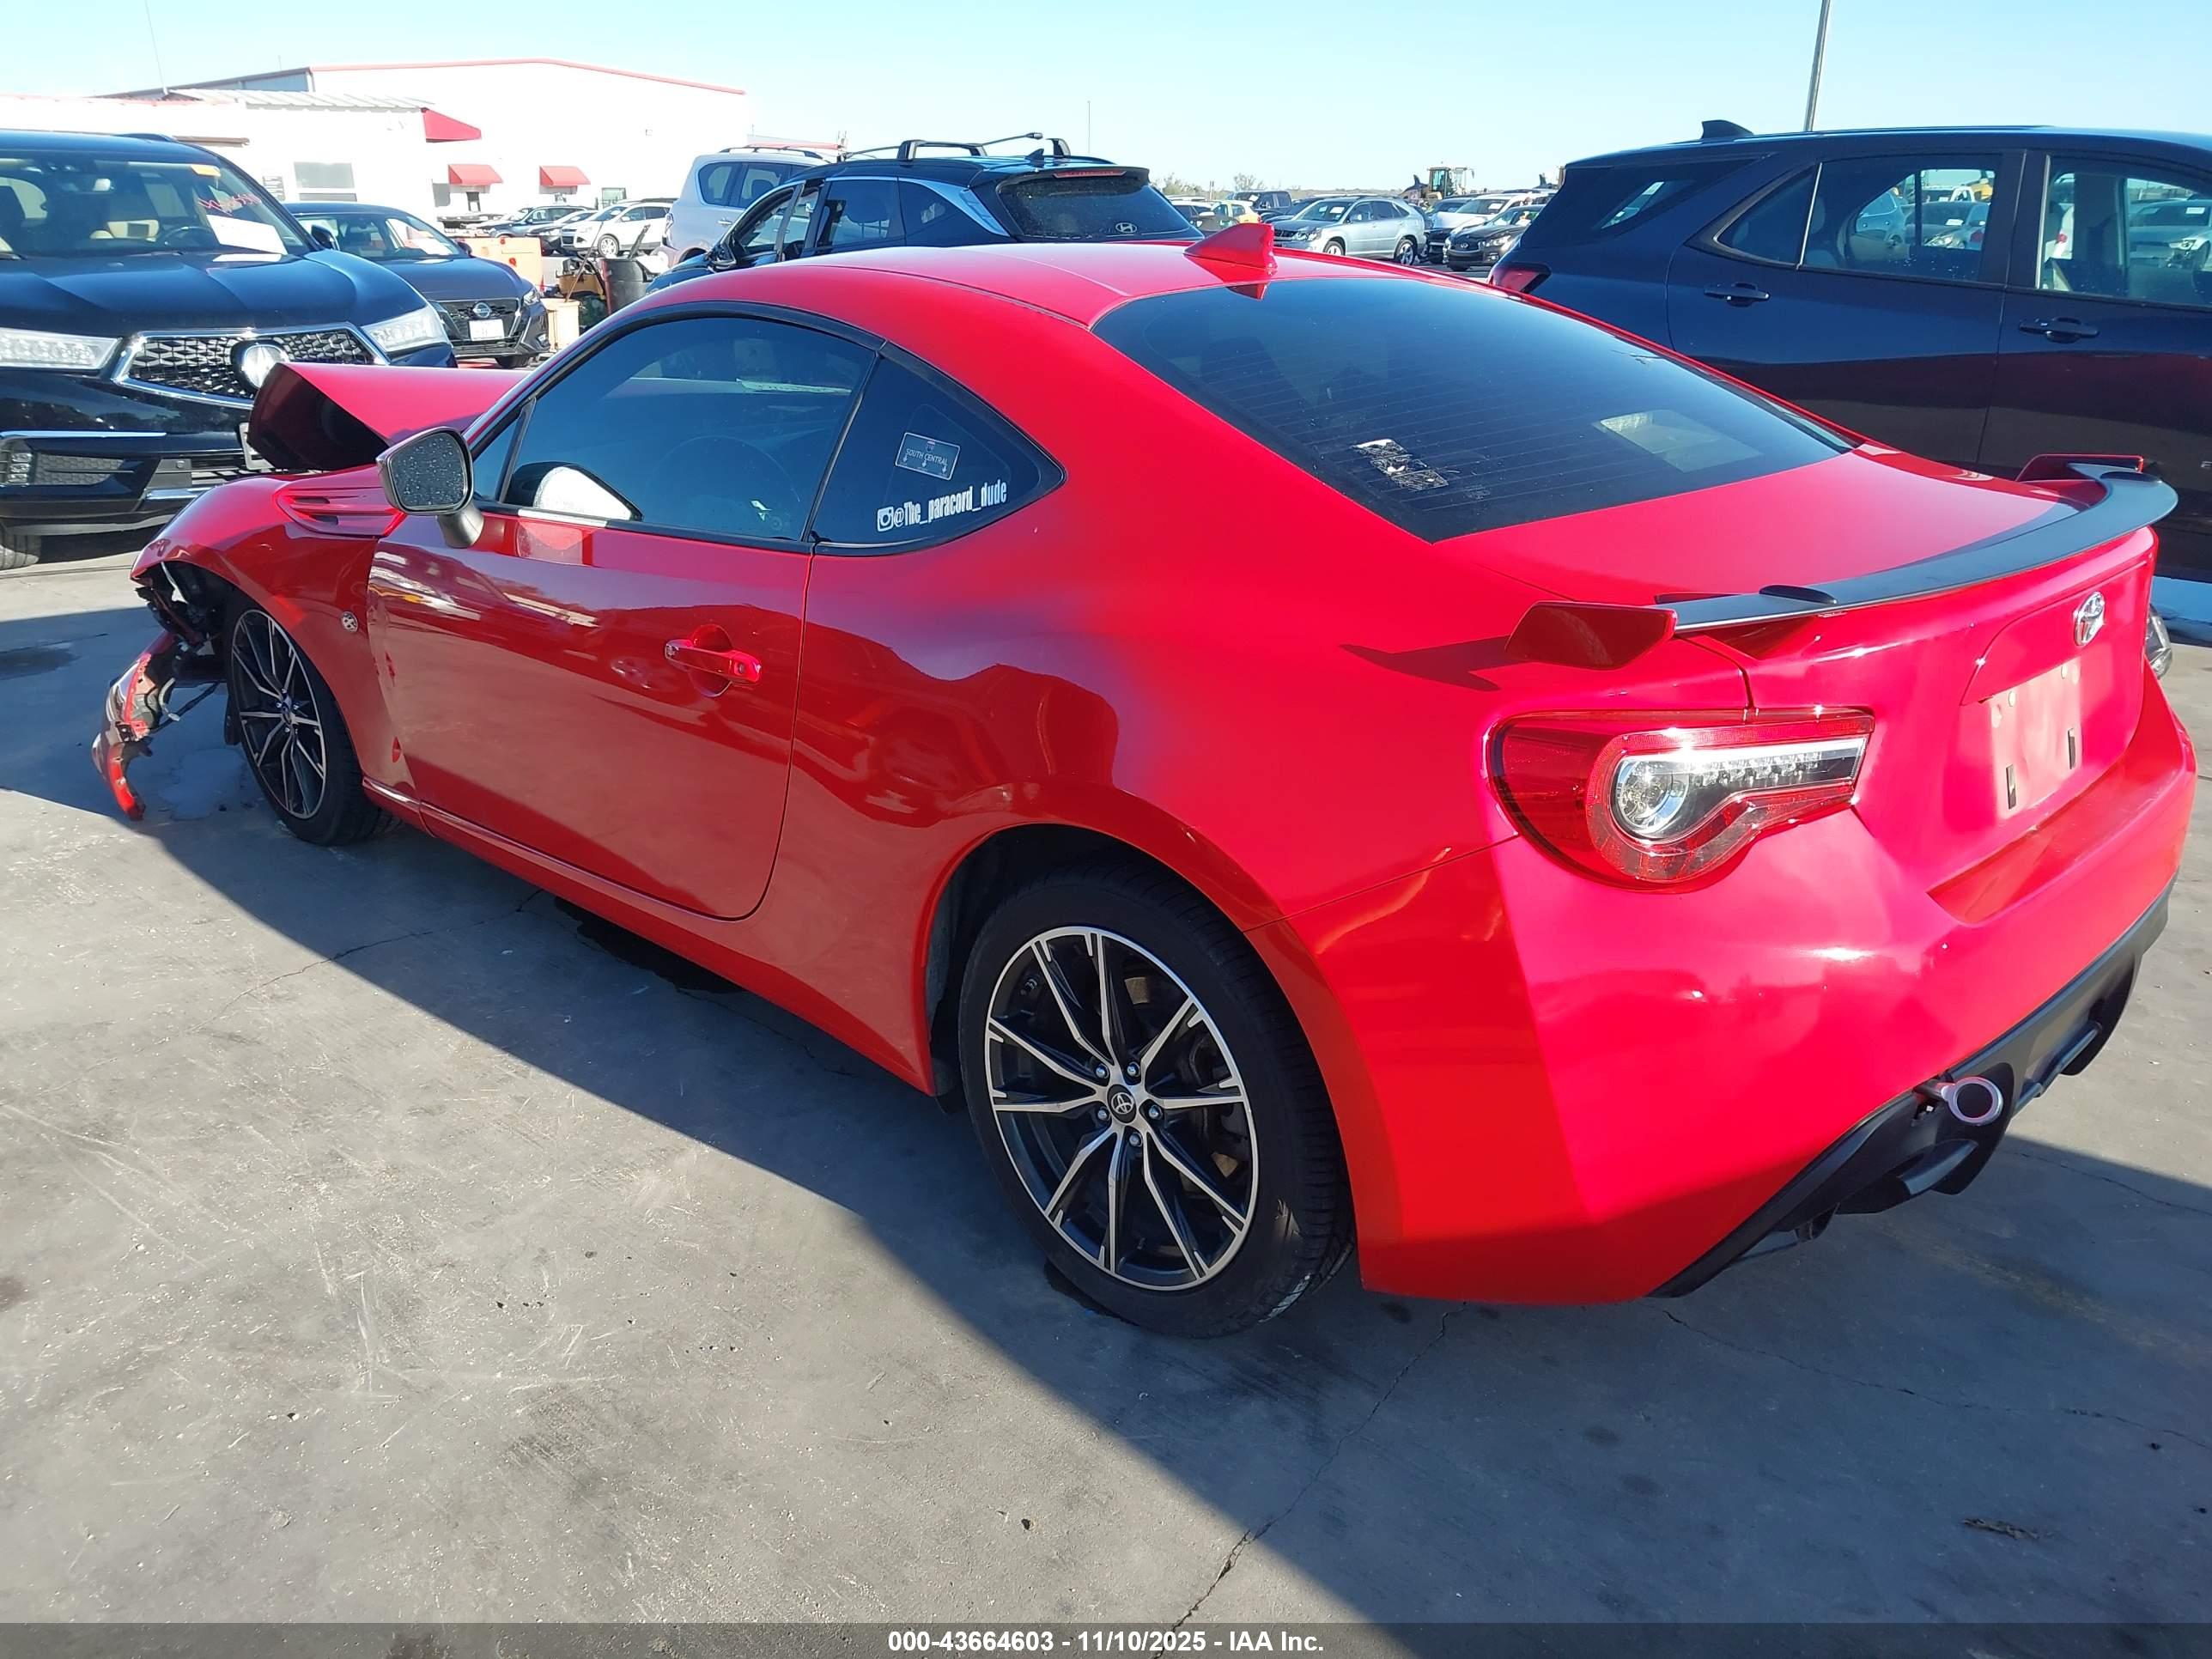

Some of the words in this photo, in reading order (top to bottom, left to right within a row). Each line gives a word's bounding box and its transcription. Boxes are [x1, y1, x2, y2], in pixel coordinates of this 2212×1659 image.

[905, 448, 924, 459] SOUTH
[924, 453, 948, 465] CENTRAL
[894, 479, 1007, 527] @The_paracord_dude
